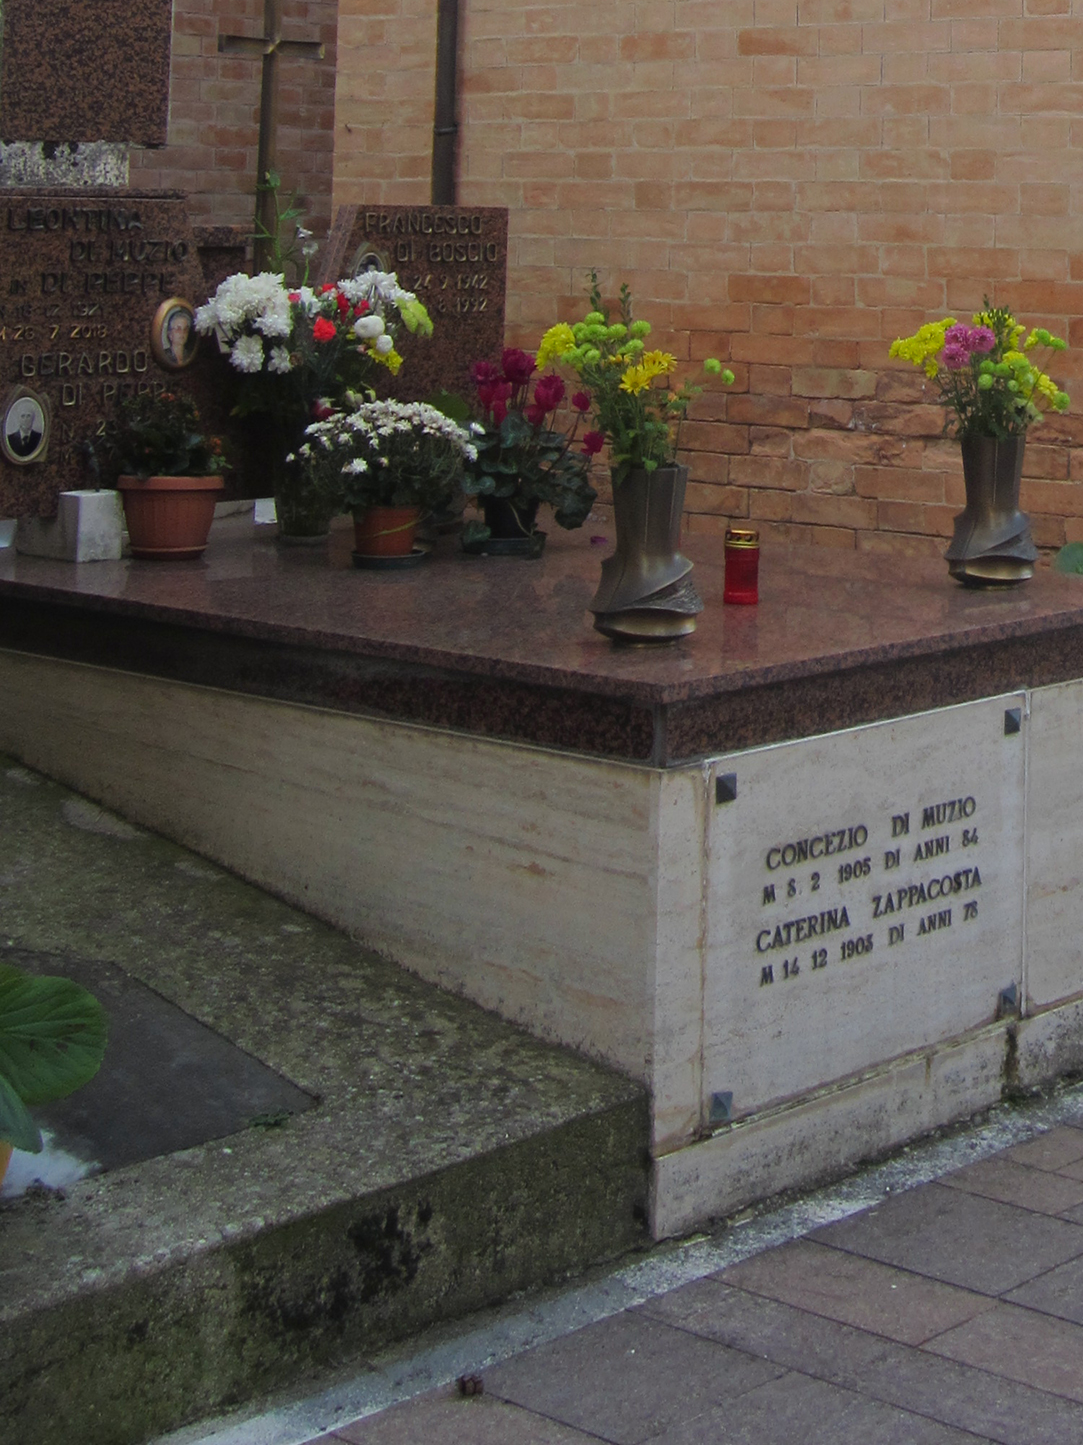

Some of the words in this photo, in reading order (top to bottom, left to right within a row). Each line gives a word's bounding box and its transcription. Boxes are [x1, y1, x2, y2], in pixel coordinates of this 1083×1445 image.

[365, 212, 483, 235] FRANCESCO
[70, 240, 97, 262] DI
[111, 239, 189, 262] MUZIO
[397, 242, 415, 262] DI
[429, 242, 498, 262] BOSCIO
[41, 272, 69, 295] DI
[455, 297, 489, 313] 1992
[49, 324, 60, 340] 7
[21, 350, 149, 377] GERARDO
[62, 383, 83, 406] DI
[103, 381, 180, 406] PEPP
[766, 824, 869, 871] CONCEZIO
[891, 812, 910, 838] DI
[921, 796, 977, 830] MUZIO
[762, 884, 777, 905] M
[811, 872, 821, 892] 2
[837, 857, 872, 884] 1905
[883, 848, 901, 871] DI
[913, 836, 951, 862] ANNI
[962, 827, 980, 848] 84
[755, 906, 851, 953] CATERINA
[872, 866, 982, 919] ZAPPACOSTA
[759, 964, 774, 987] M
[782, 957, 800, 980] 14
[811, 948, 828, 971] 12
[888, 923, 905, 946] DI
[916, 908, 952, 936] ANNI
